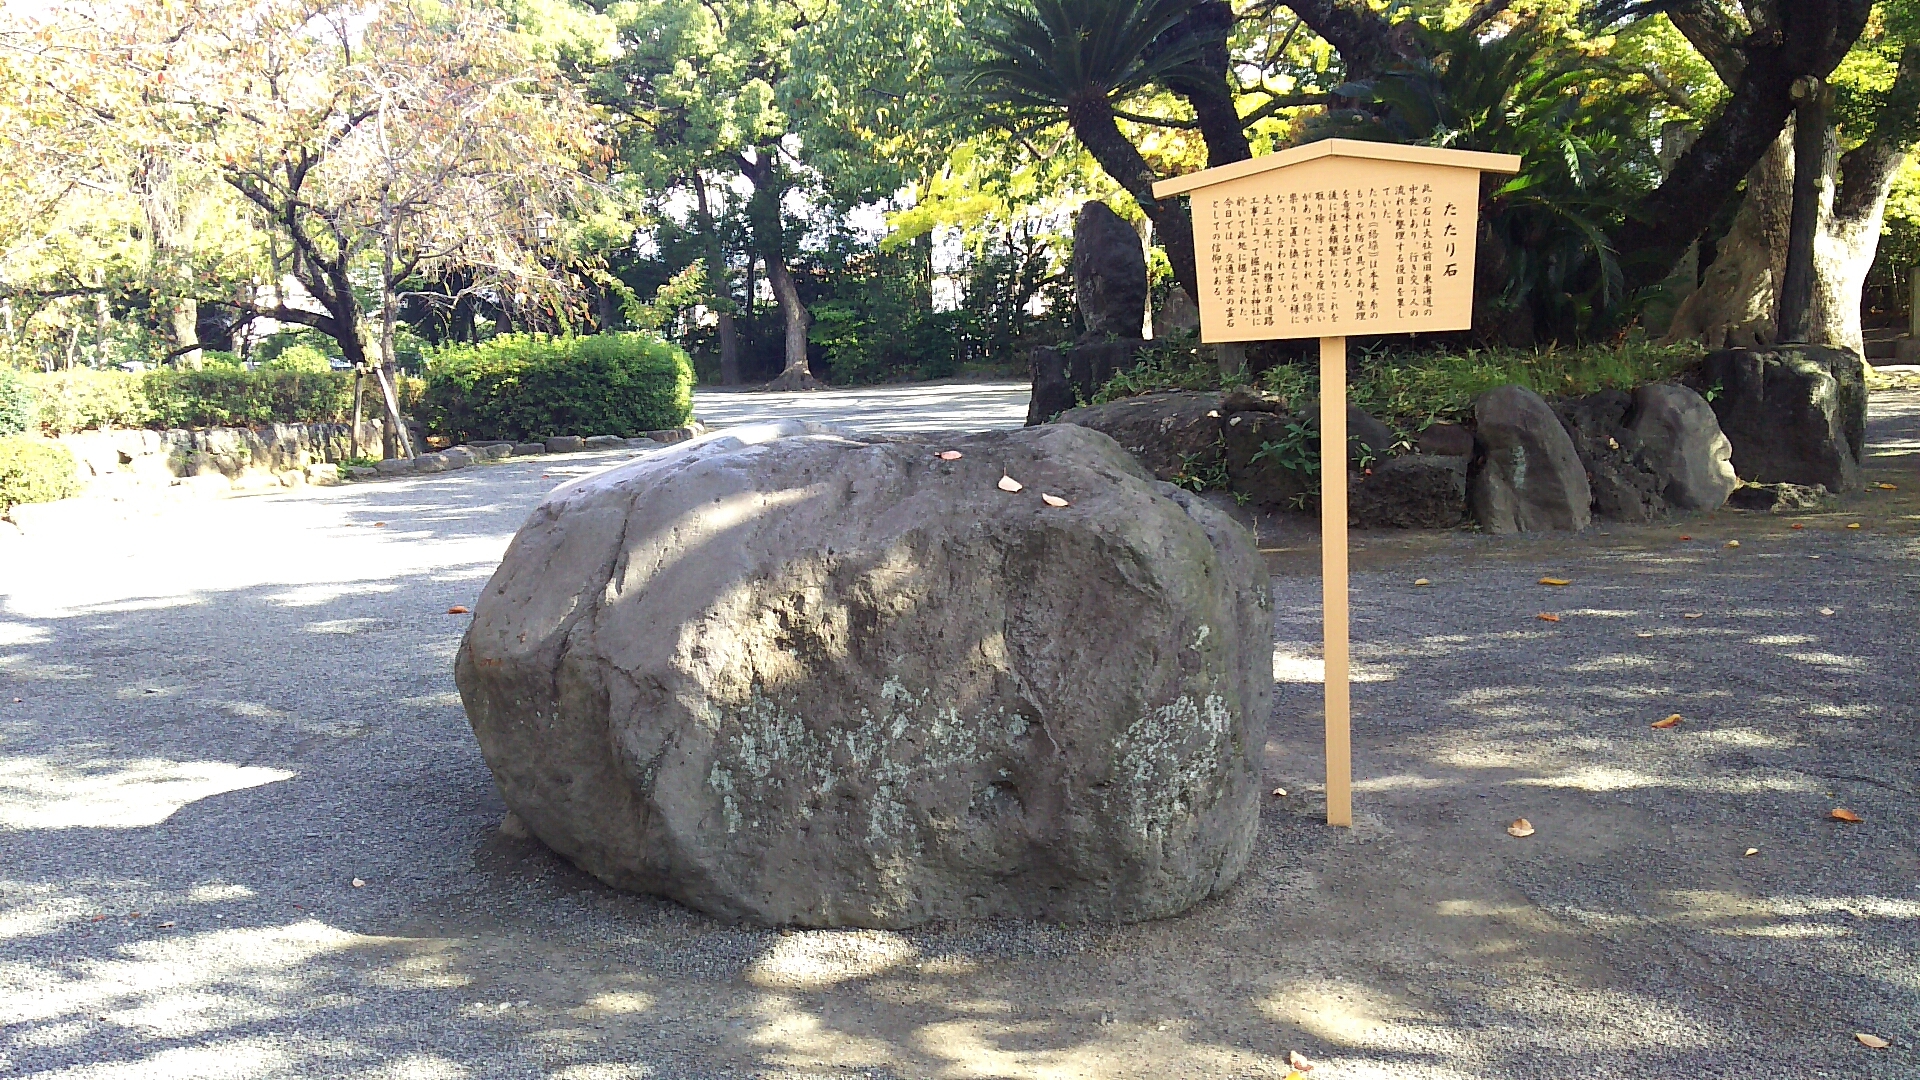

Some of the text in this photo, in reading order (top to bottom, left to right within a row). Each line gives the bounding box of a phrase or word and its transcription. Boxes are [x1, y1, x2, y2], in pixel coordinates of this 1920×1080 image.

[1276, 195, 1286, 307] なったと言われている。
[1355, 189, 1366, 320] もつれを防ぐ具であり整理
[1383, 187, 1391, 223] ていた。
[1395, 185, 1406, 318] 流れを整理する役目を果し
[1422, 184, 1433, 316] 此の石は大社前旧東海道の
[1443, 202, 1458, 277] たたり石
